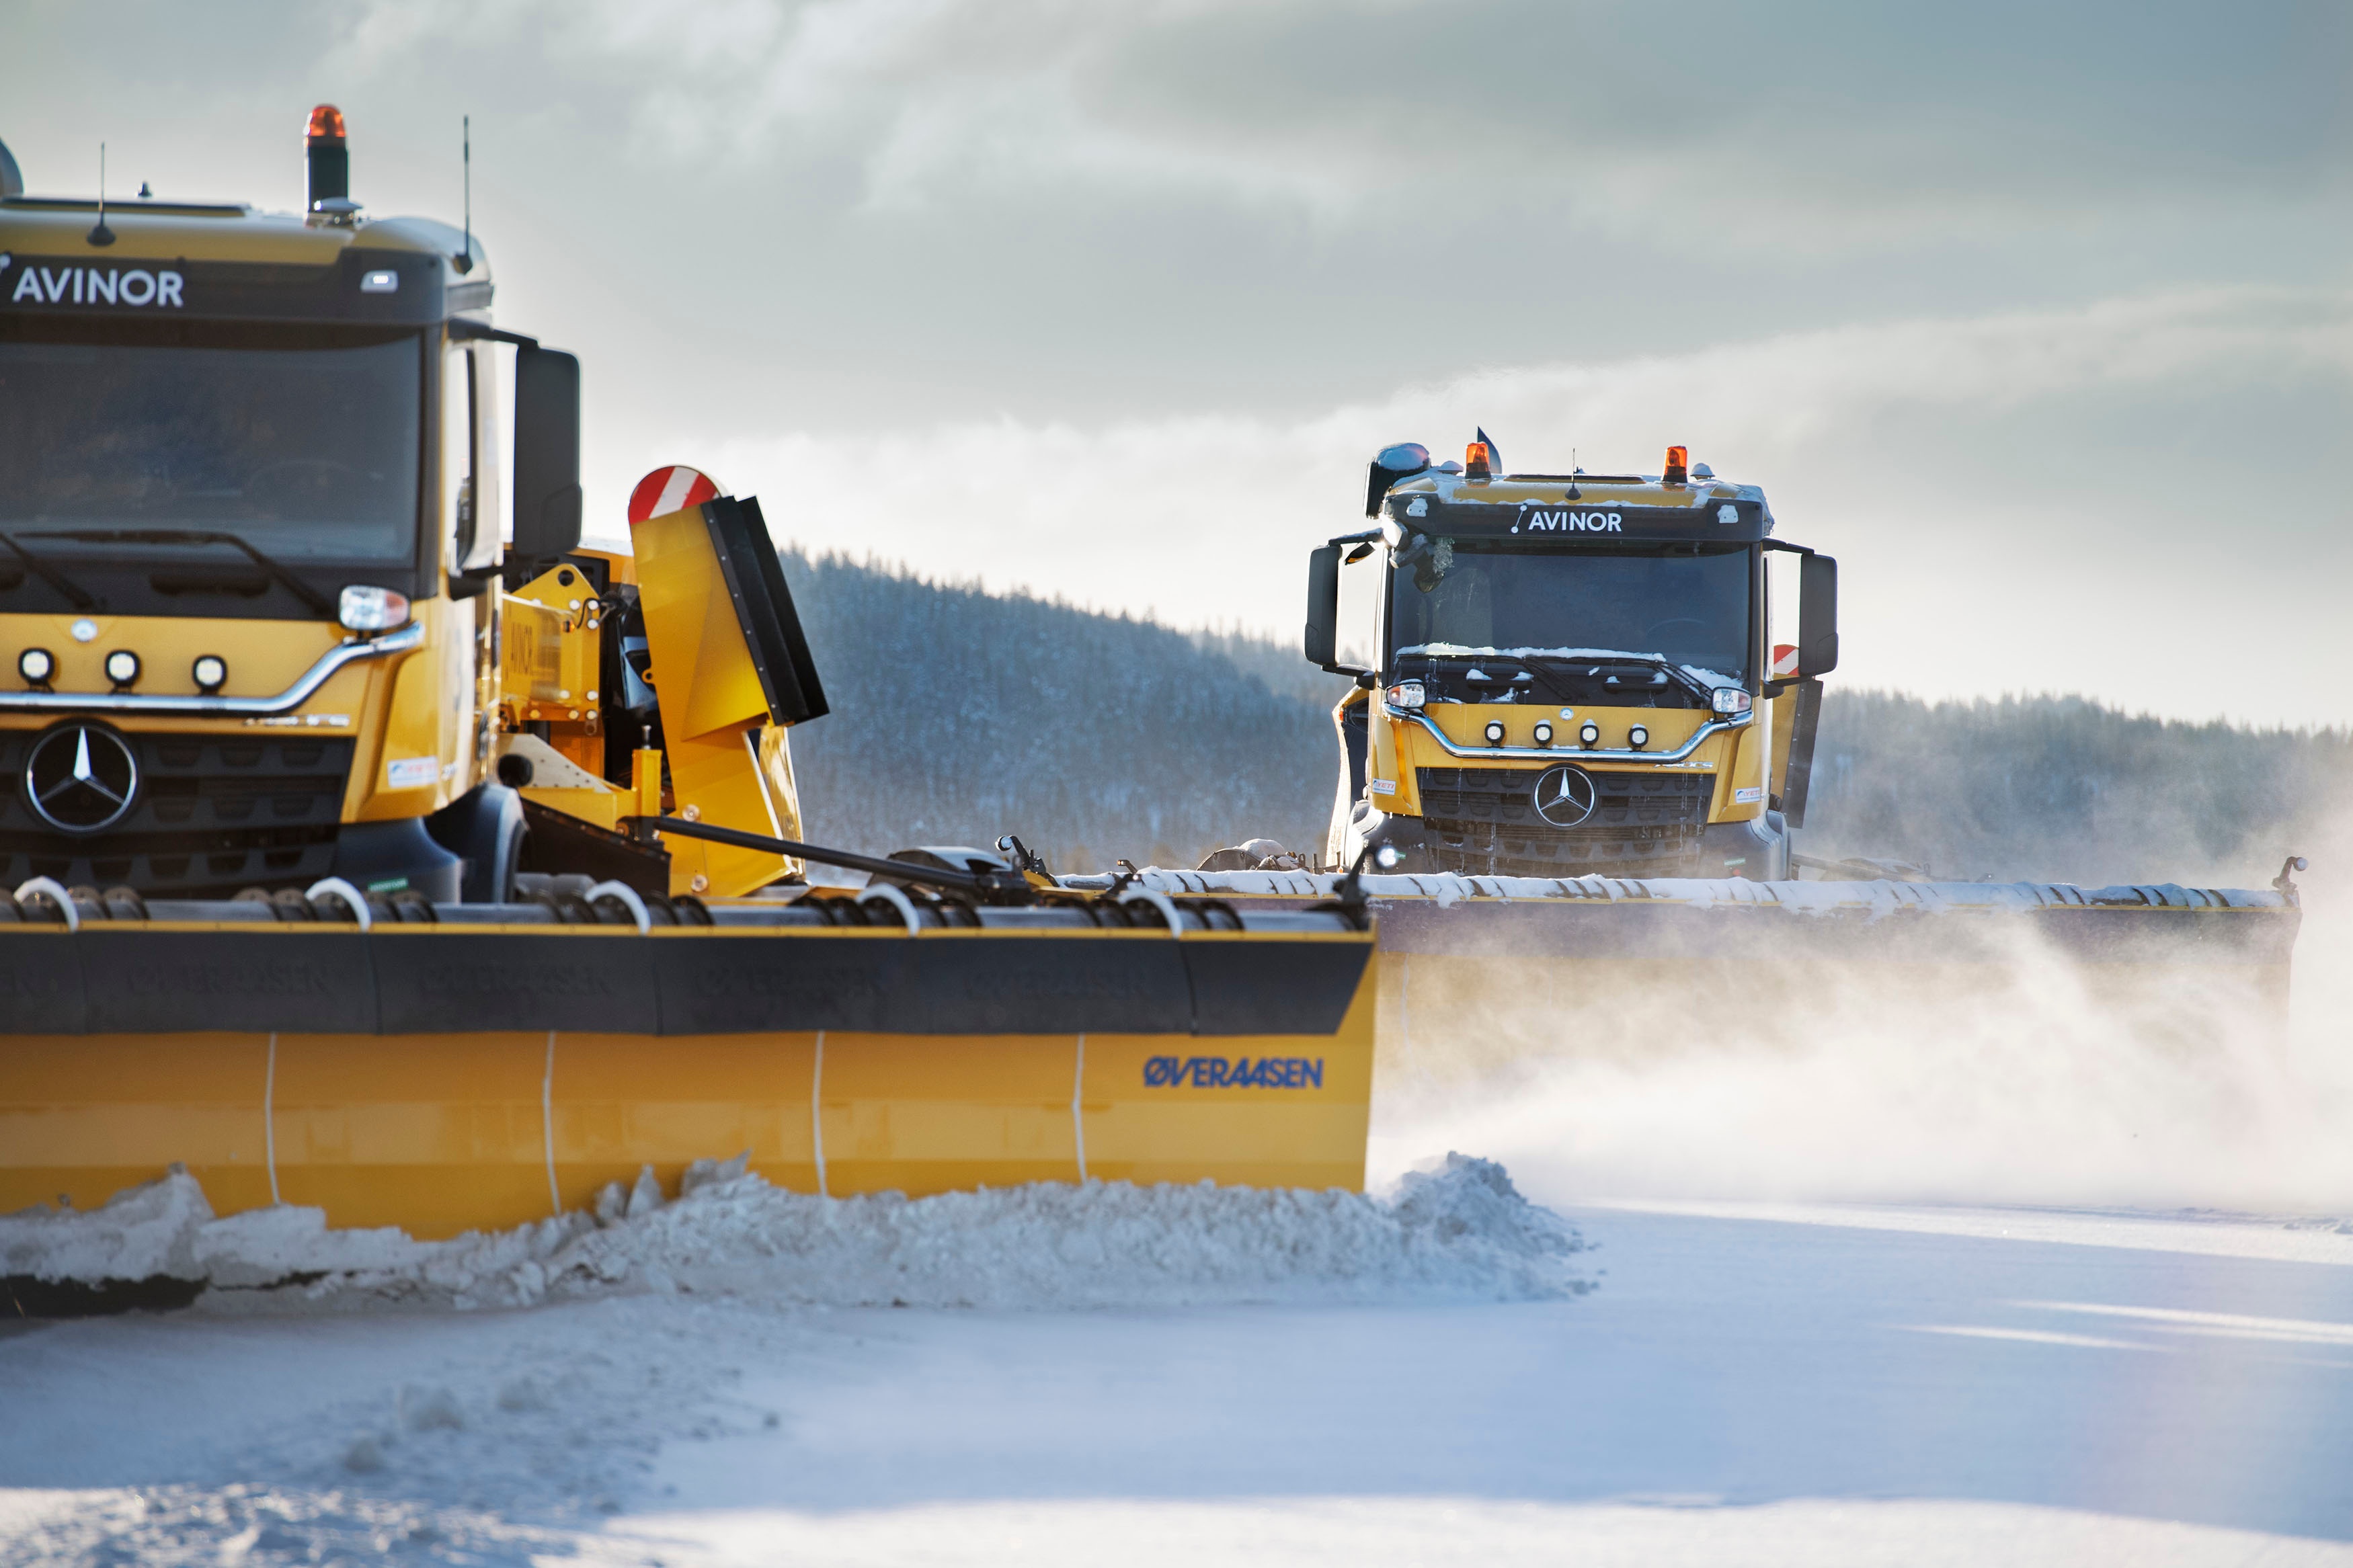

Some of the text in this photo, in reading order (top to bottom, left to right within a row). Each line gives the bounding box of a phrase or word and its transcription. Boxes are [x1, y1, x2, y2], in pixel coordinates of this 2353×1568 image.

[12, 267, 184, 307] AVINOR
[1527, 511, 1622, 532] AVINOR
[1144, 1055, 1323, 1088] ØVERAASEN
